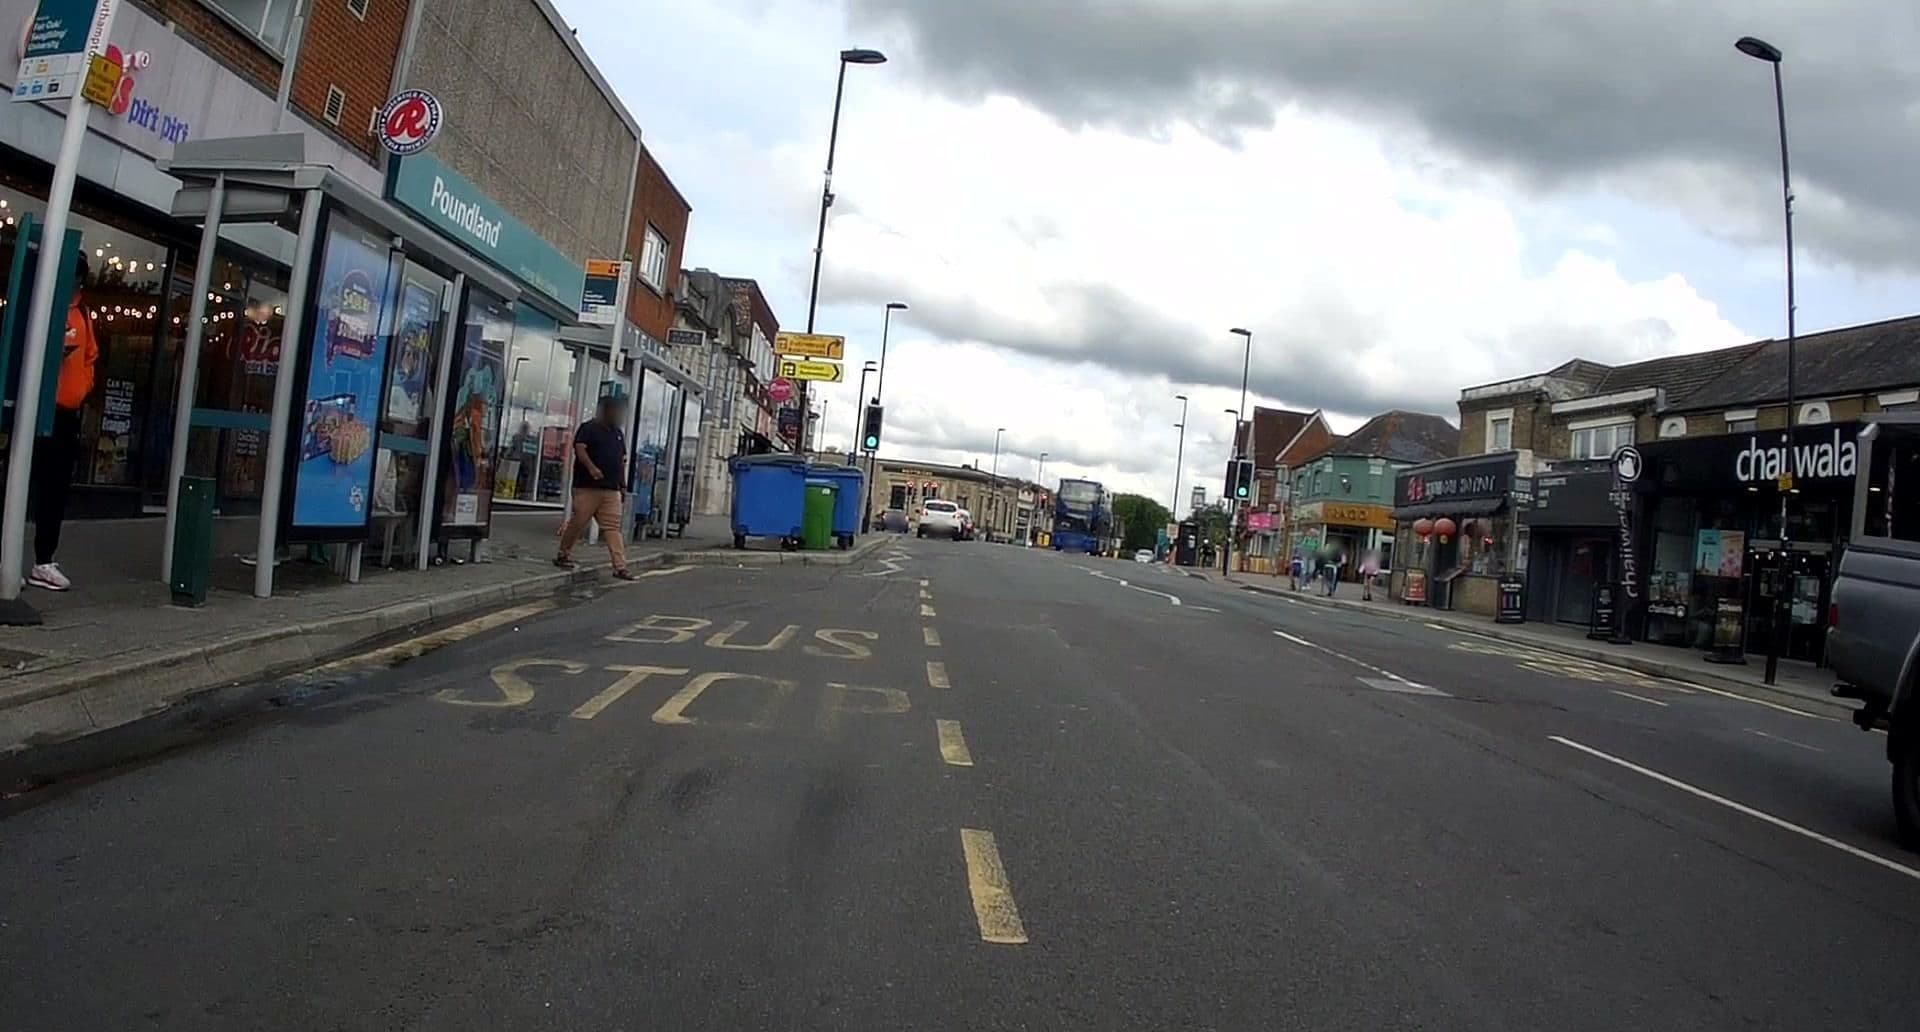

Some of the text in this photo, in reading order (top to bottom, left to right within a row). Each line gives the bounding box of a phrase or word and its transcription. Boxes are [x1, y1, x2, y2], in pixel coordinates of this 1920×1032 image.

[128, 97, 189, 143] piri piri
[429, 175, 502, 249] Poundland
[604, 614, 880, 660] BUS
